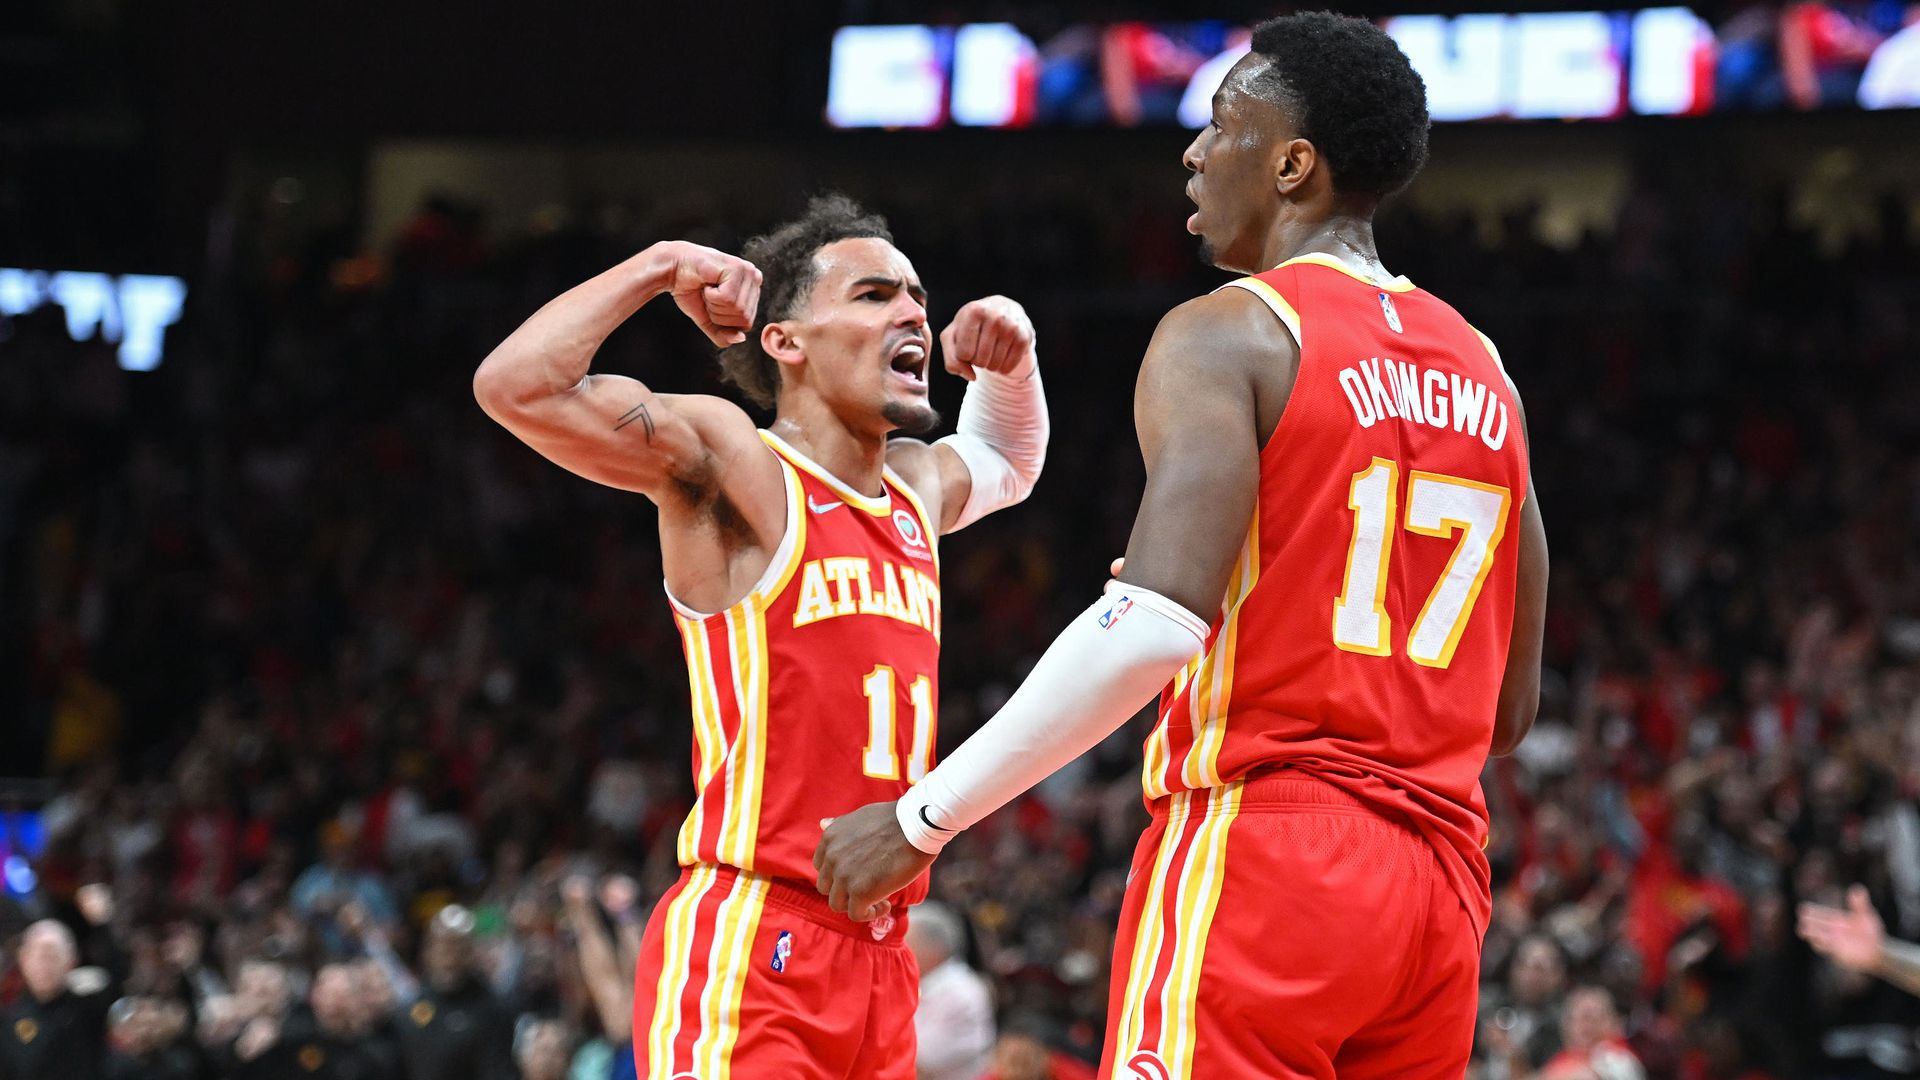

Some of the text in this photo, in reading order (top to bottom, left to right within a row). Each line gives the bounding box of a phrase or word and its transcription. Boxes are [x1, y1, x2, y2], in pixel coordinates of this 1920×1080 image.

[1338, 357, 1508, 451] OKONGWU
[1332, 455, 1512, 669] 17
[862, 663, 934, 786] 11
